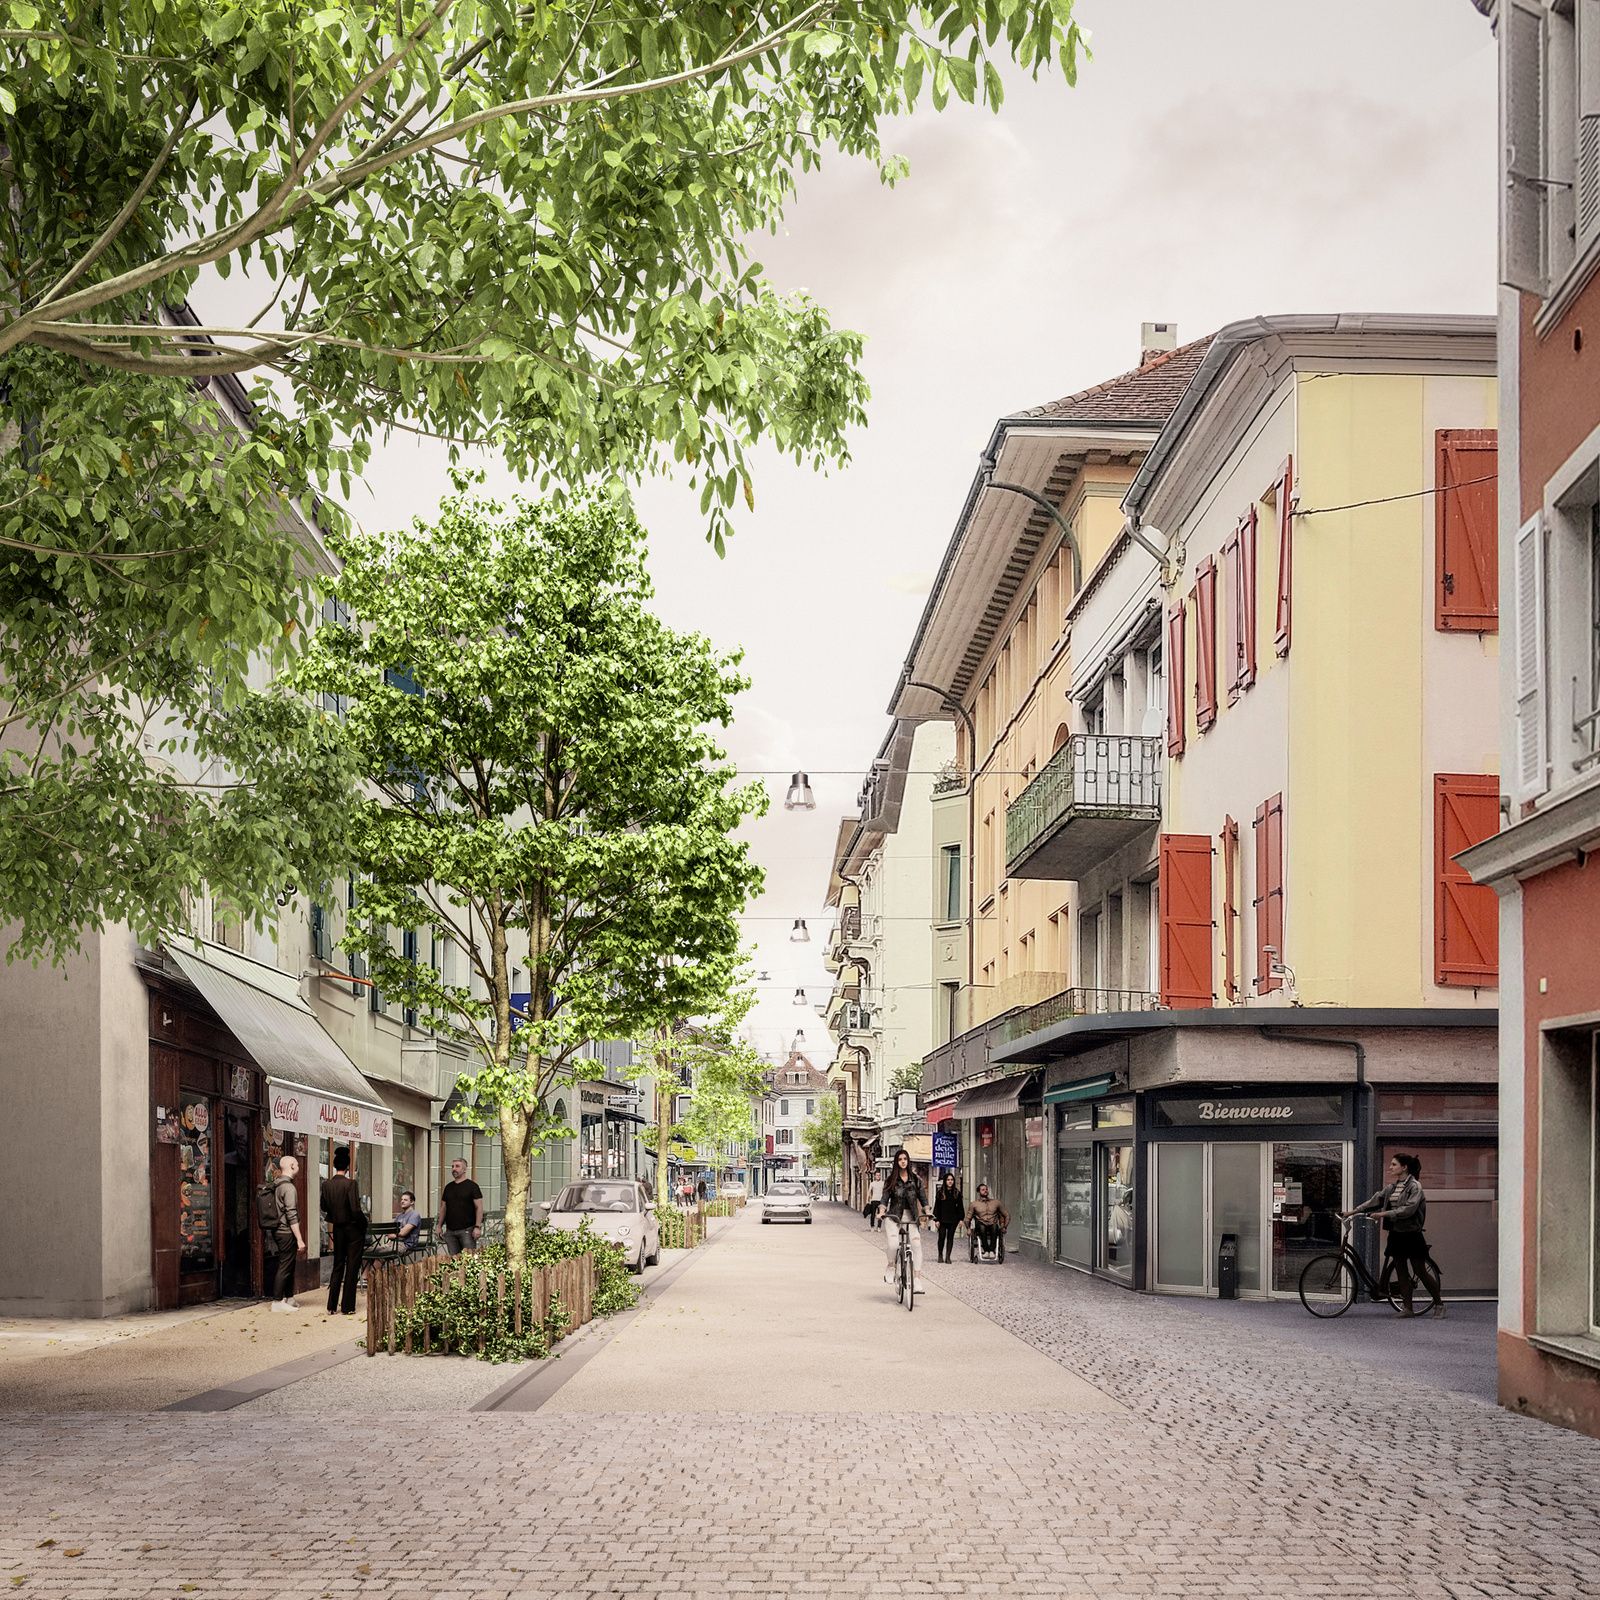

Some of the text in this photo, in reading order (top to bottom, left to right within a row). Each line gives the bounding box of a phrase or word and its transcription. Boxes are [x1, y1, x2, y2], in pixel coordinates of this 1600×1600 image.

[320, 1103, 360, 1127] ALLO KEBAB
[1198, 1102, 1293, 1119] Bienvenue
[935, 1144, 955, 1152] deux
[935, 1151, 955, 1159] mille
